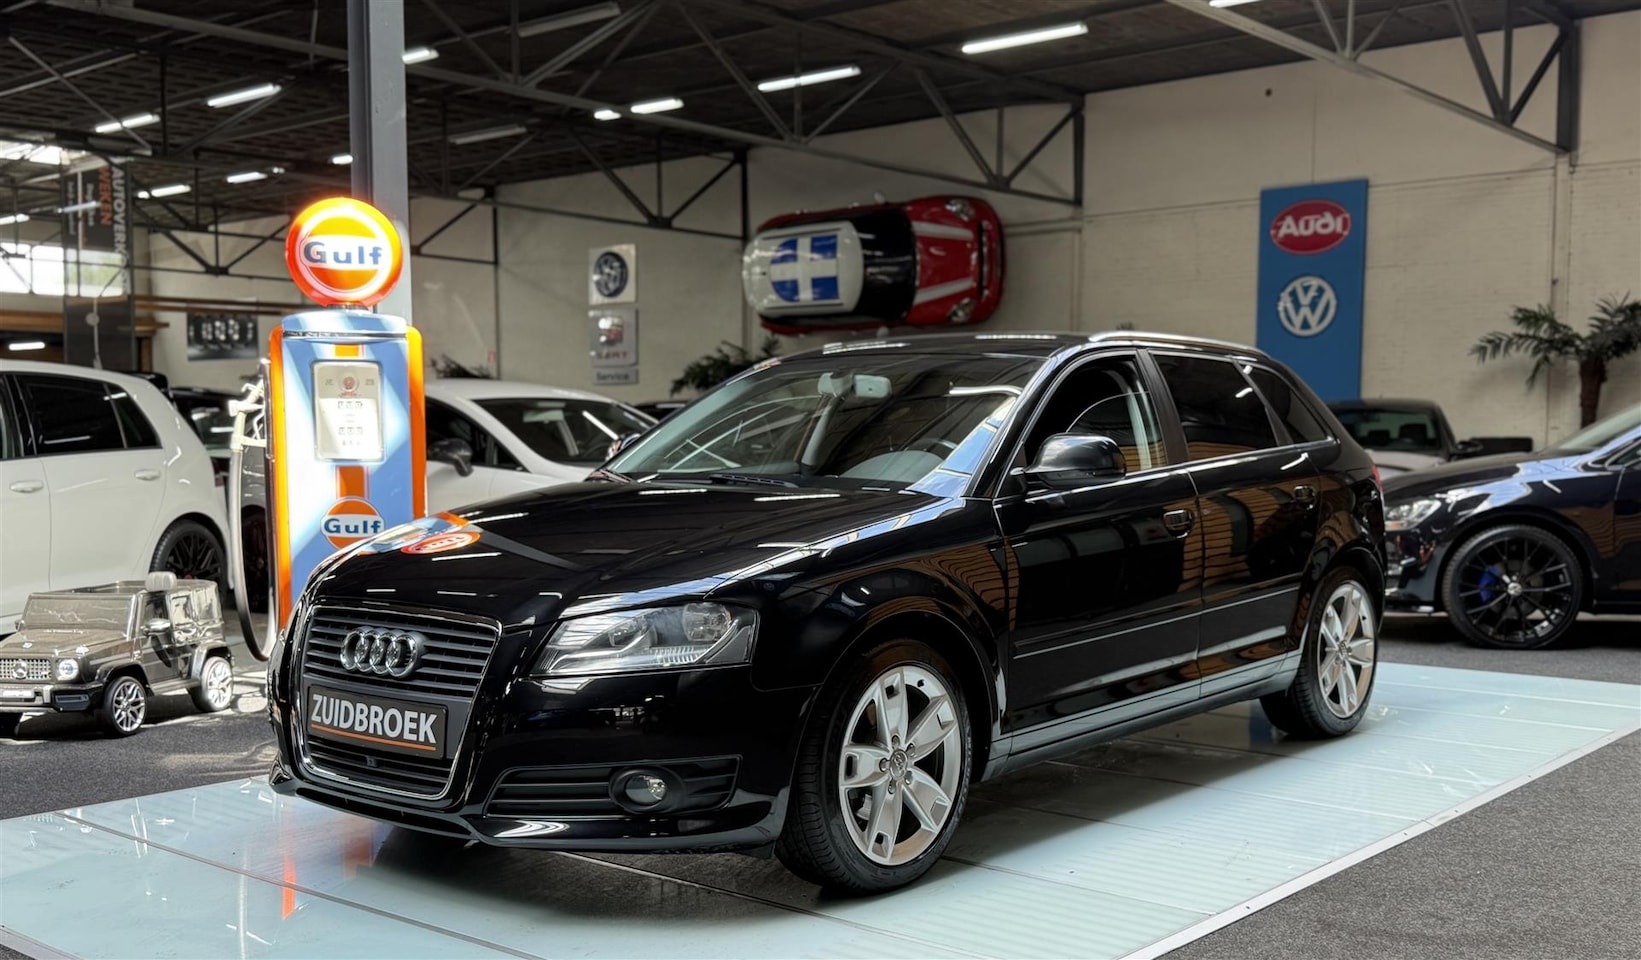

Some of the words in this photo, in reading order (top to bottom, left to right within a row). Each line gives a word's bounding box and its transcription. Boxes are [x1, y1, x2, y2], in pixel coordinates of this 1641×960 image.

[303, 241, 383, 265] Gulf
[324, 518, 381, 534] Gulf
[311, 694, 437, 744] ZUIDBROEK
